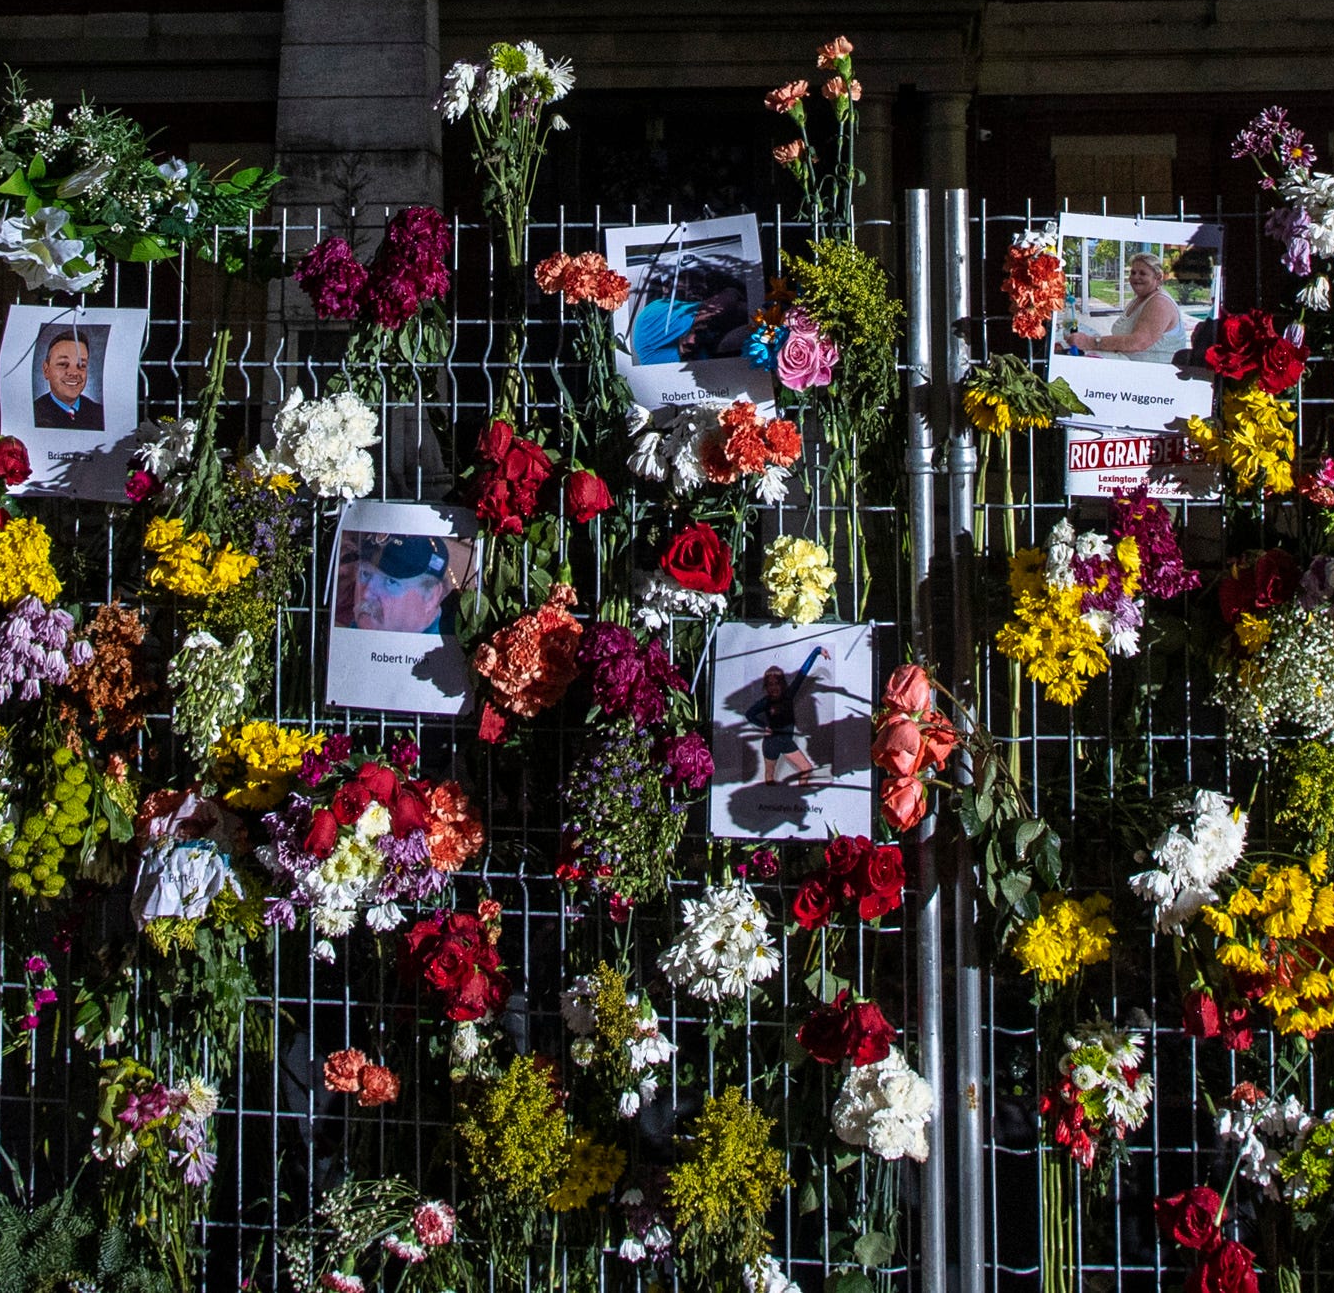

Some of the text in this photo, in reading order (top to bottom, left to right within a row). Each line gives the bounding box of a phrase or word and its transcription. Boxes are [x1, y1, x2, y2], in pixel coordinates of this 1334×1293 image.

[661, 387, 730, 402] Robert Daniel
[1084, 388, 1175, 405] Jamey Waggoner
[1070, 442, 1099, 469] RIO
[1098, 474, 1138, 484] Lexington
[1098, 484, 1137, 494] Frafor
[370, 652, 430, 666] Robert Irwin
